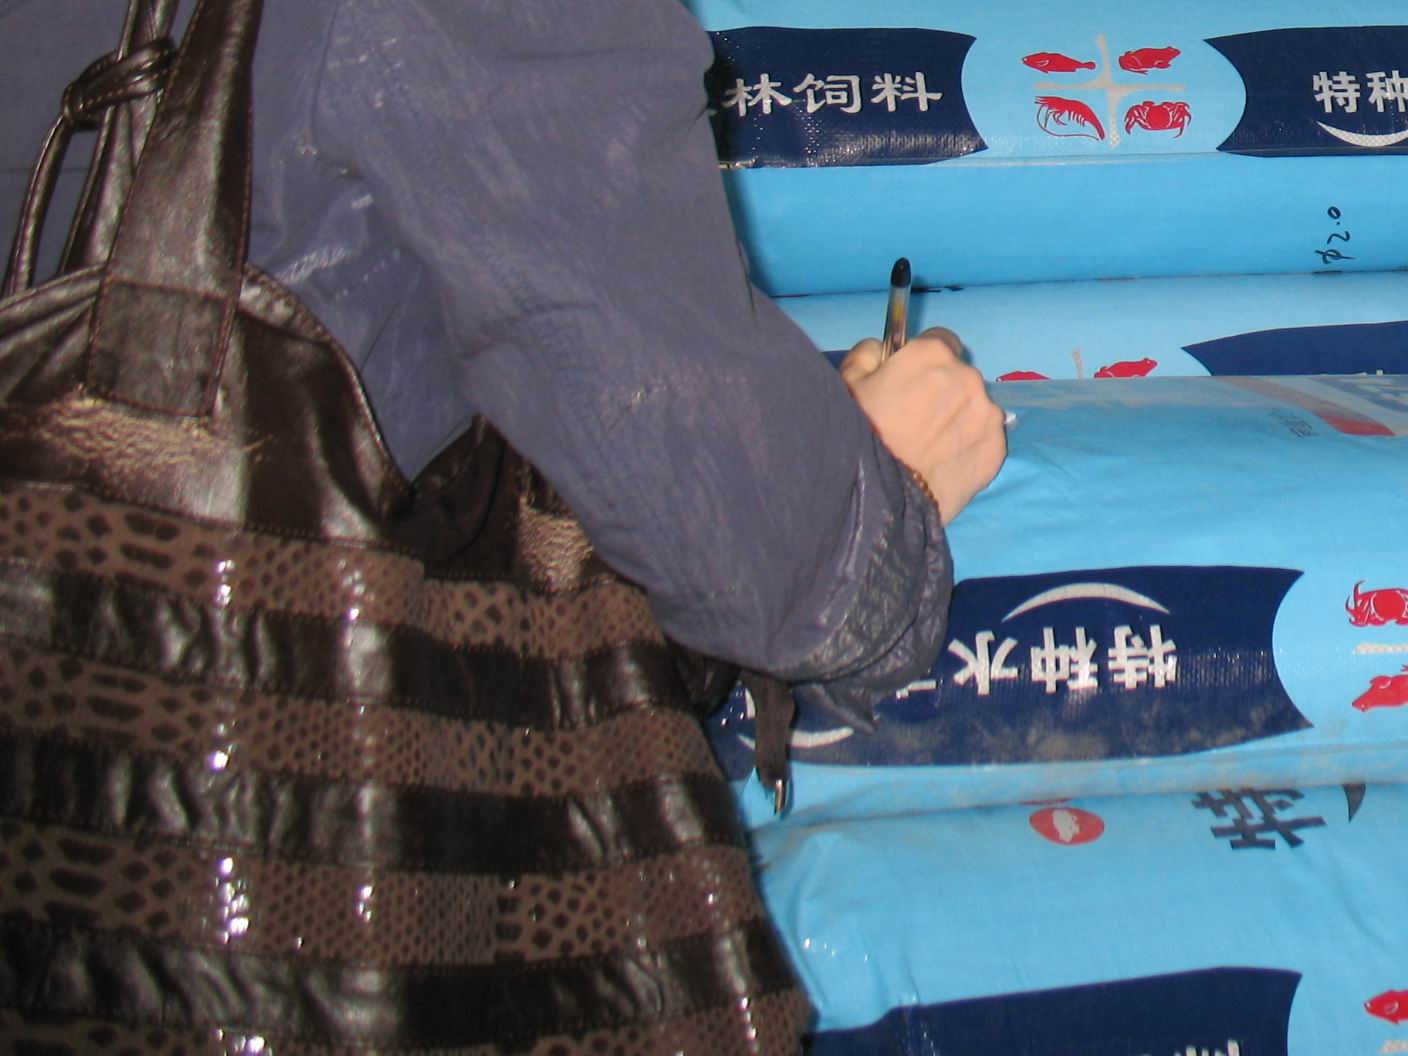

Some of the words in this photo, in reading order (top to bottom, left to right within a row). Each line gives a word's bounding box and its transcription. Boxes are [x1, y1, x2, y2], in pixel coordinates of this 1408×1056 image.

[707, 72, 943, 117] 林饲料
[896, 625, 1177, 697] 特种水
